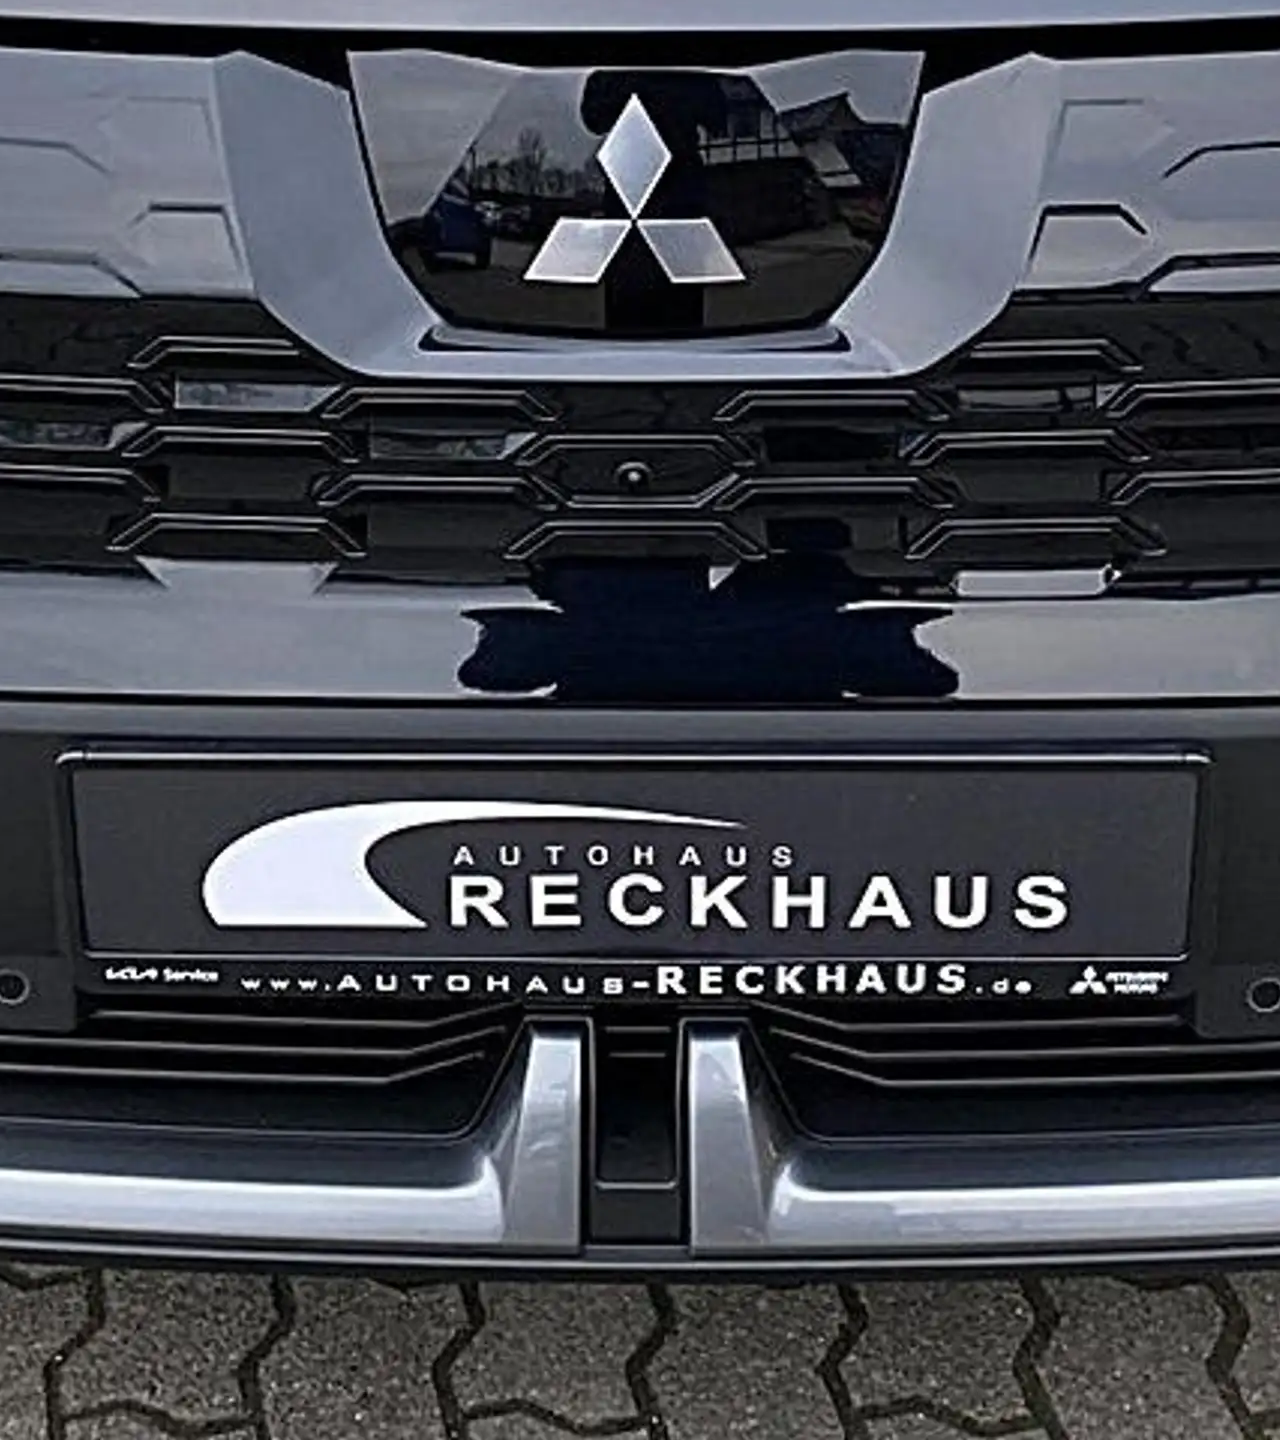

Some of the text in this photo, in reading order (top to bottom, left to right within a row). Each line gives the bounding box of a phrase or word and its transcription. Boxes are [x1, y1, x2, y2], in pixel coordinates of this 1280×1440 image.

[453, 845, 793, 868] AUTOHAUS
[449, 873, 1069, 929] RECKHAUS
[240, 963, 1032, 995] www.AUTOHAUS-RECKHAUS.de
